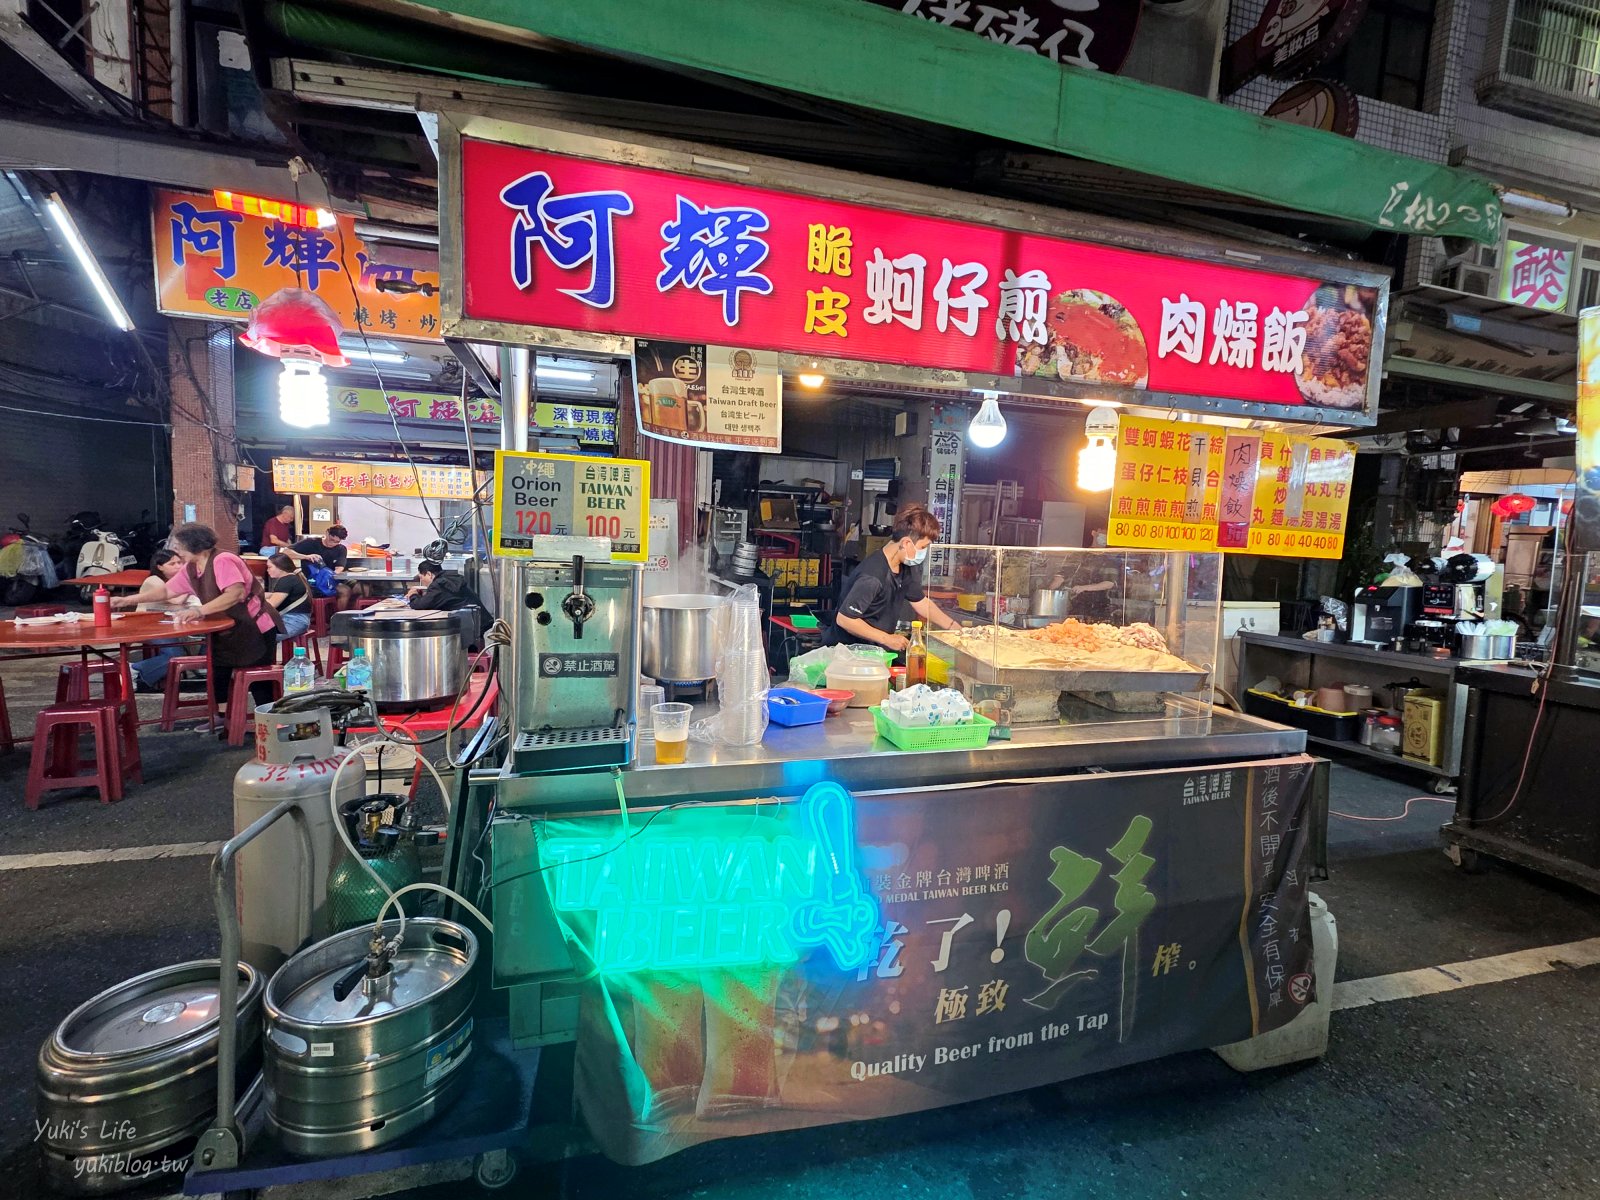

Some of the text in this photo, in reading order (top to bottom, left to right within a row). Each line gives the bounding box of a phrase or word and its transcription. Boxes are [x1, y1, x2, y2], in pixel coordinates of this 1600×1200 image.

[500, 171, 773, 326] 阿輝
[803, 223, 853, 338] 脆皮
[210, 290, 252, 309] 老店
[863, 247, 1052, 345] 蚵仔煎
[1157, 297, 1310, 375] 肉燥飯
[676, 360, 698, 379] 生
[721, 385, 765, 397] 台灣生啤酒
[709, 397, 777, 409] Taiwan Draft Beer
[520, 460, 556, 478] 沖繩
[511, 476, 561, 492] Orion
[579, 482, 633, 497] TAIWAN
[1116, 427, 1140, 536] 雙蛋煎 80
[1133, 429, 1158, 537] 蚵仔煎 80
[1150, 431, 1175, 538] 蝦仁煎 80
[1166, 432, 1191, 539] 花枝煎 100
[1200, 435, 1224, 541] 綜合煎 120
[514, 492, 558, 507] Beer
[587, 497, 626, 510] BEER
[515, 510, 568, 536] 120 元
[586, 515, 635, 539] 100 元
[1182, 527, 1196, 540] 100
[1251, 532, 1262, 545] 10
[1268, 533, 1280, 546] 80
[1284, 533, 1296, 546] 40
[1298, 535, 1312, 547] 40
[1313, 536, 1327, 549] 40
[1327, 537, 1338, 549] 80
[563, 660, 615, 672] 禁止酒駕
[1183, 791, 1231, 806] TAIWAN BEER
[549, 837, 818, 909] TAIWAN
[886, 893, 920, 904] MEDAL
[923, 888, 959, 901] TAIWAN
[962, 884, 987, 895] BEER
[989, 882, 1009, 892] KEG
[599, 905, 799, 968] BEER
[935, 979, 1010, 1024] 極致
[850, 1013, 1108, 1081] Quality Beer from the Tap
